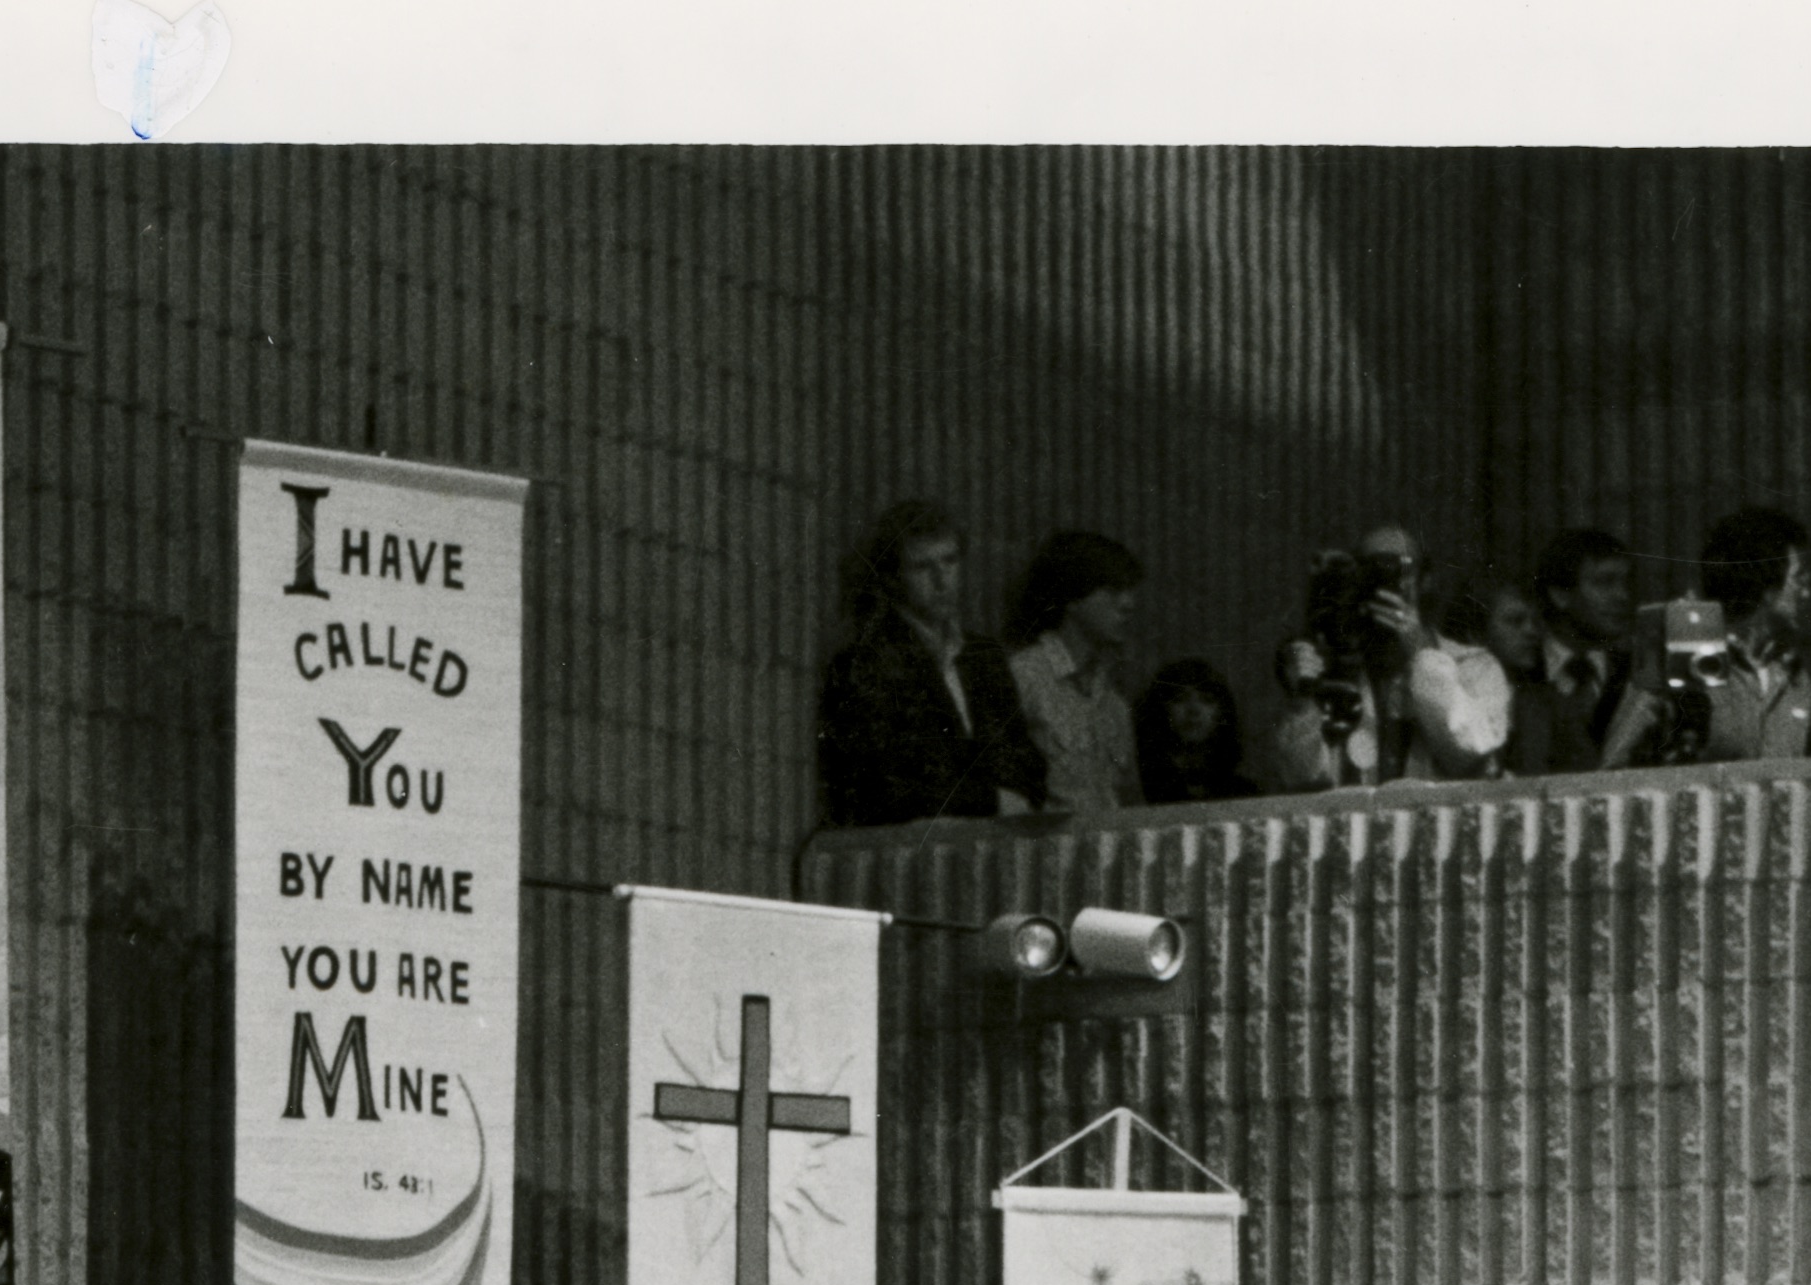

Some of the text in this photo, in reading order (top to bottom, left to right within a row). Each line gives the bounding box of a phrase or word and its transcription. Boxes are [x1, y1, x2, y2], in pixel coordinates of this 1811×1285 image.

[280, 481, 465, 601] I HAVE
[293, 620, 469, 698] CALLED
[317, 716, 445, 815] YOU
[279, 851, 474, 915] BY NAME
[280, 944, 471, 1005] YOU ARE
[279, 1011, 450, 1122] MINE
